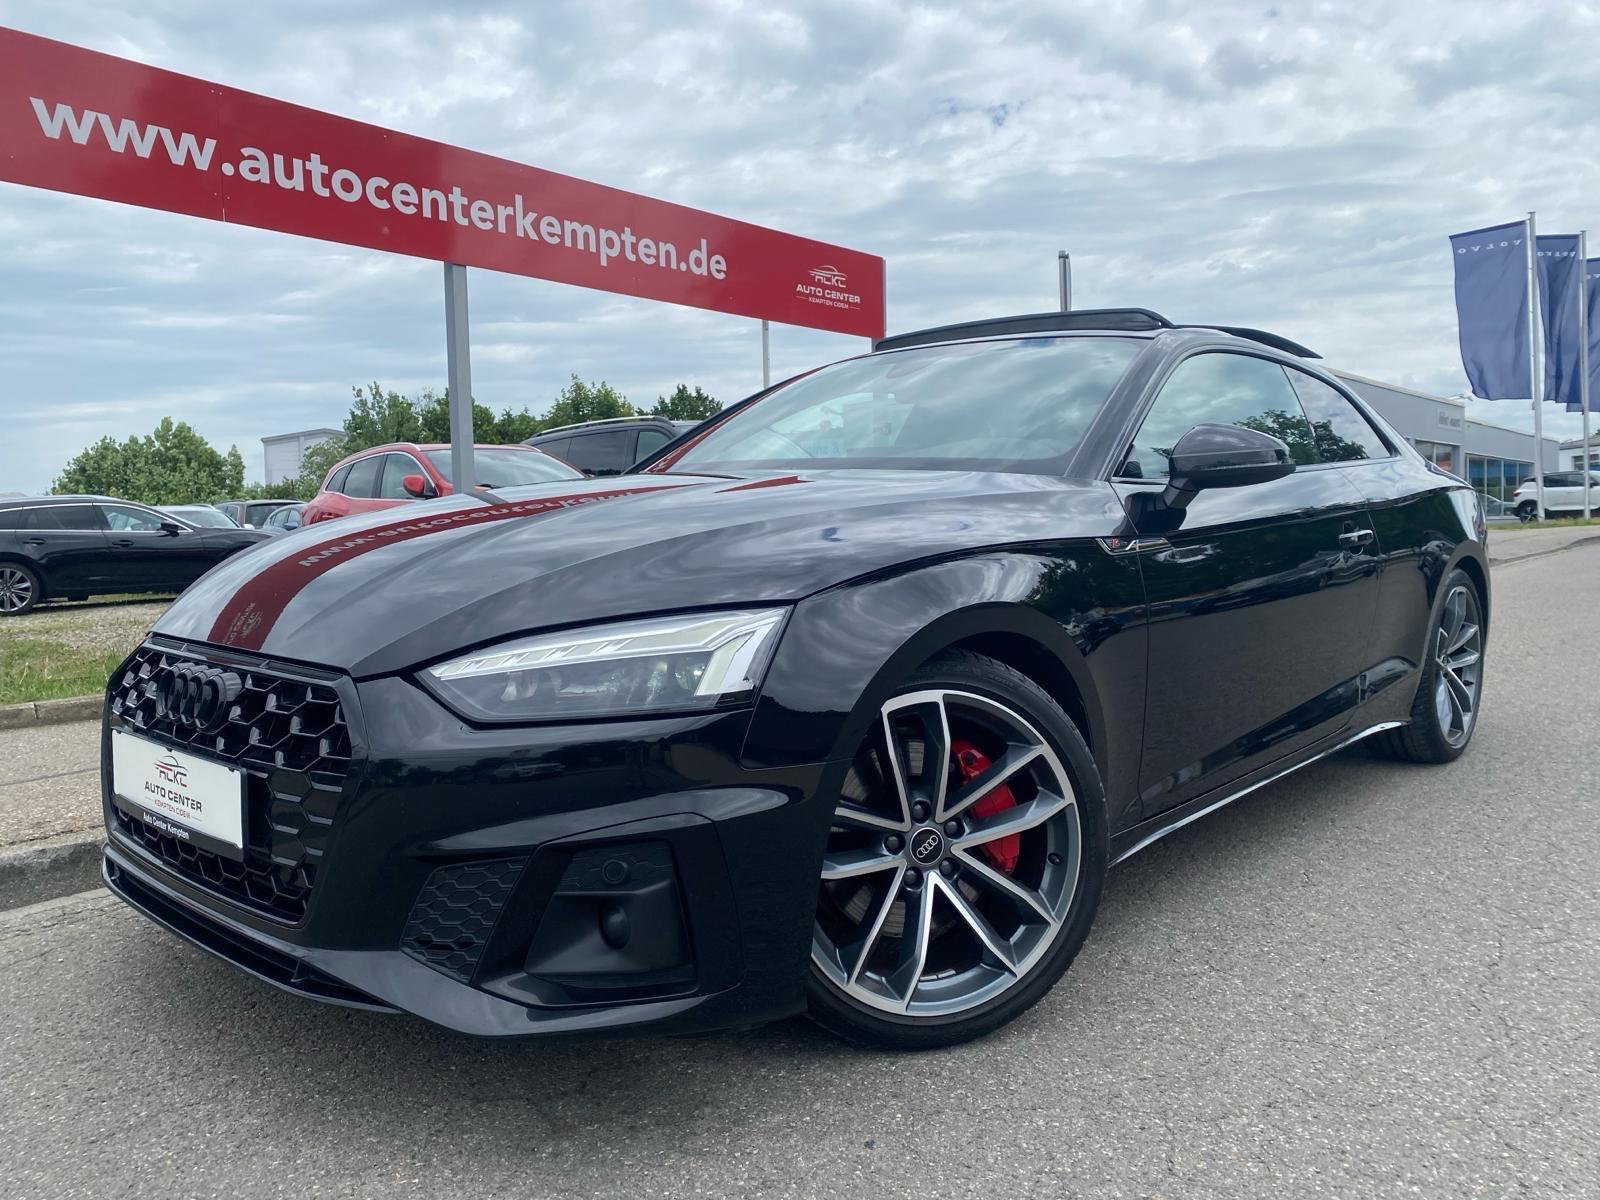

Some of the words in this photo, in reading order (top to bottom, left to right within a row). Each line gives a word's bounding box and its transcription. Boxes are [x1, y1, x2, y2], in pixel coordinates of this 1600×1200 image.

[30, 96, 727, 280] www.autocenterkempten.de
[796, 284, 823, 296] AUTO
[825, 290, 860, 304] CENTER
[145, 781, 165, 798] AUTO
[167, 790, 202, 812] CENTER
